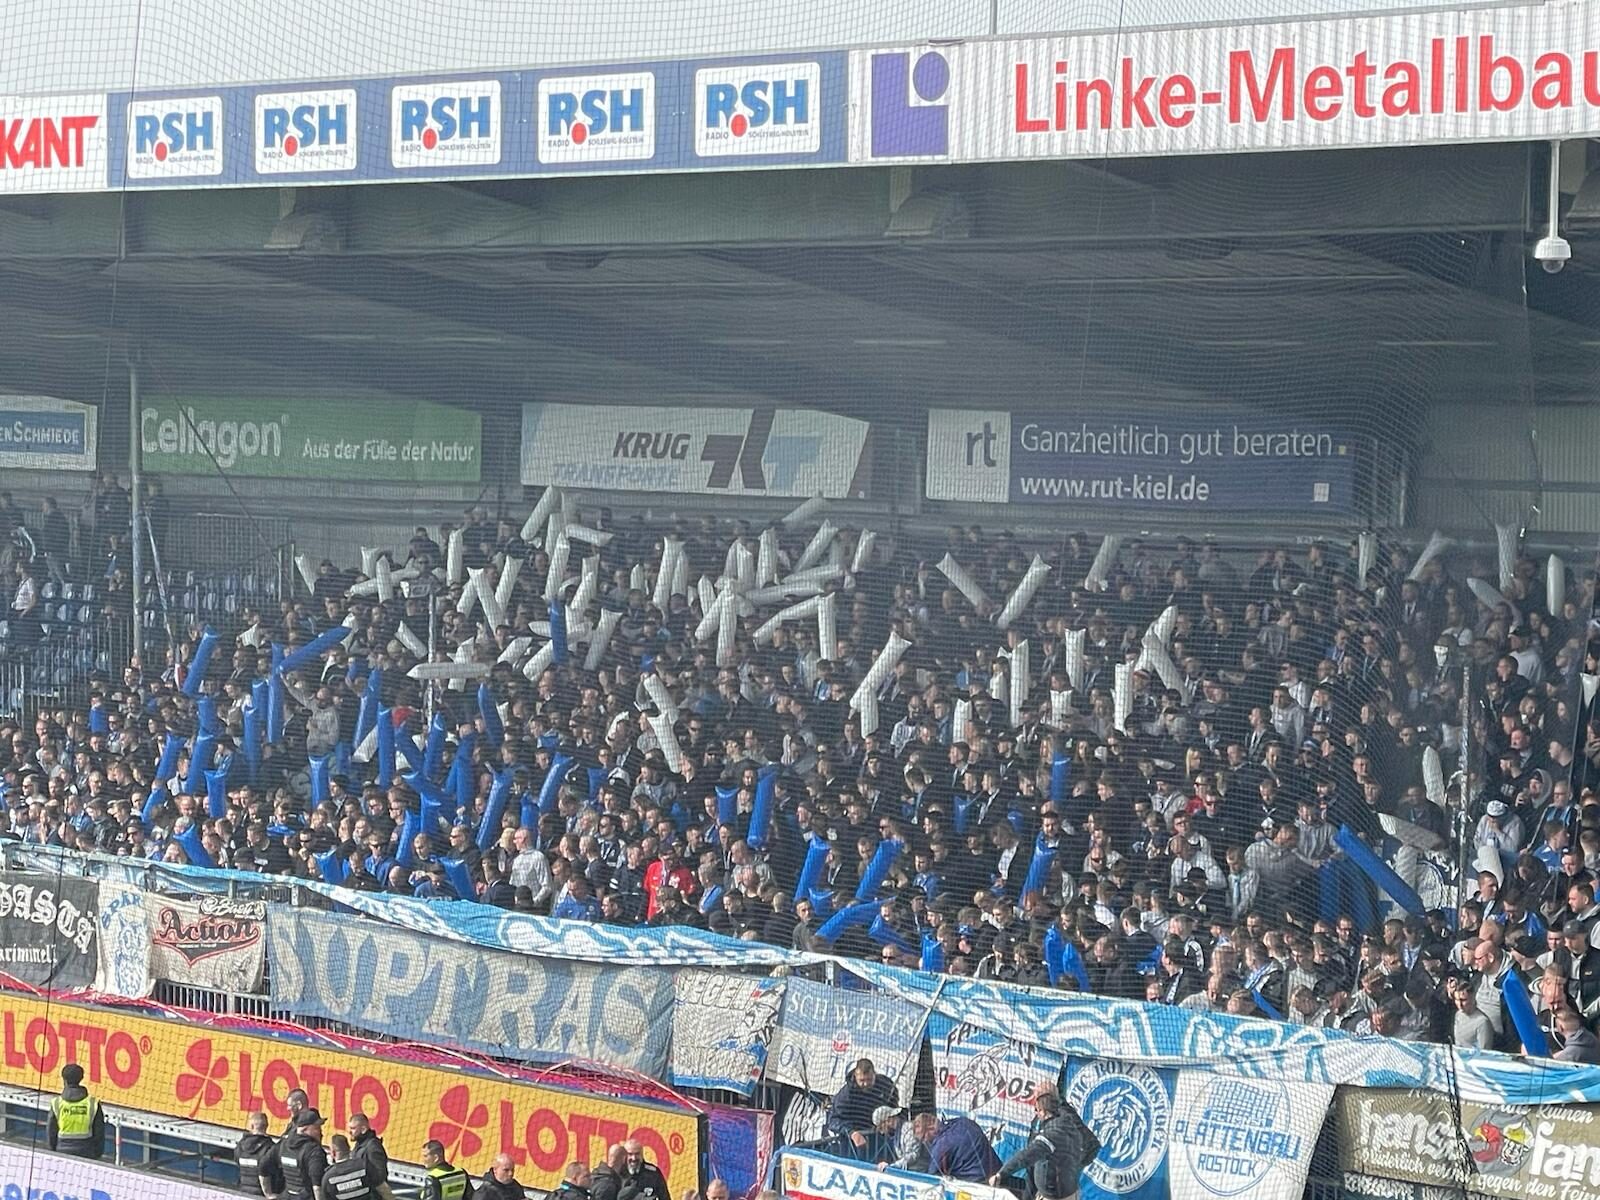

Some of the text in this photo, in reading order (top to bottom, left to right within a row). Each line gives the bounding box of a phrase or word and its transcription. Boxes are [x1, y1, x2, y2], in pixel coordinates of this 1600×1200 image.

[401, 96, 491, 141] RSH
[549, 88, 645, 136] RSH
[706, 79, 809, 128] RSH
[0, 116, 99, 169] KANT
[136, 112, 214, 154] RSH
[264, 105, 348, 149] RSH
[705, 132, 729, 140] RADIO
[302, 438, 474, 462] Aus der Fülle der Natur
[612, 432, 692, 461] KRUG
[965, 421, 998, 468] rt
[1020, 423, 1169, 457] Ganzheitlich
[1179, 428, 1224, 464] gut
[1020, 474, 1210, 502] www.rut-kiel.de
[156, 906, 260, 942] Action
[1536, 1103, 1594, 1123] Ruinen
[1197, 1153, 1257, 1178] ROSTOCK
[1478, 1174, 1523, 1194] gegen
[1525, 1178, 1557, 1198] den
